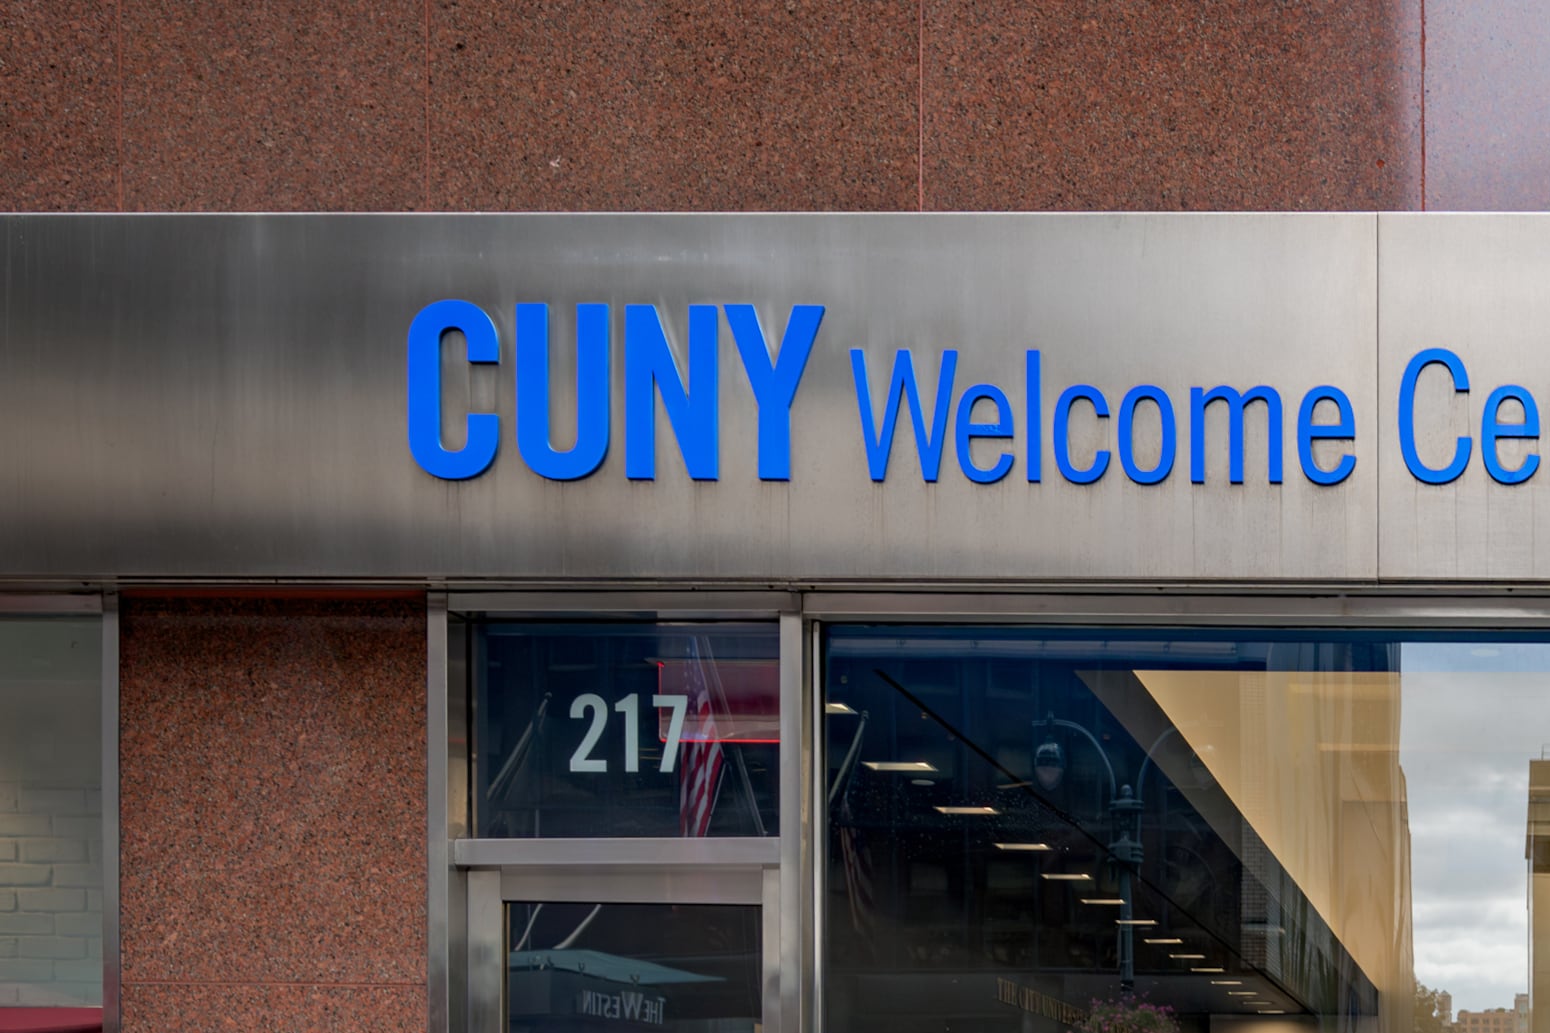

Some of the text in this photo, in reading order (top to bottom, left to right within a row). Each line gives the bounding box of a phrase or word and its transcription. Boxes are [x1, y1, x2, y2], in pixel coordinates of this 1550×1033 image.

[408, 300, 826, 482] CUNY
[850, 348, 1357, 485] Welcome
[570, 693, 688, 773] 217
